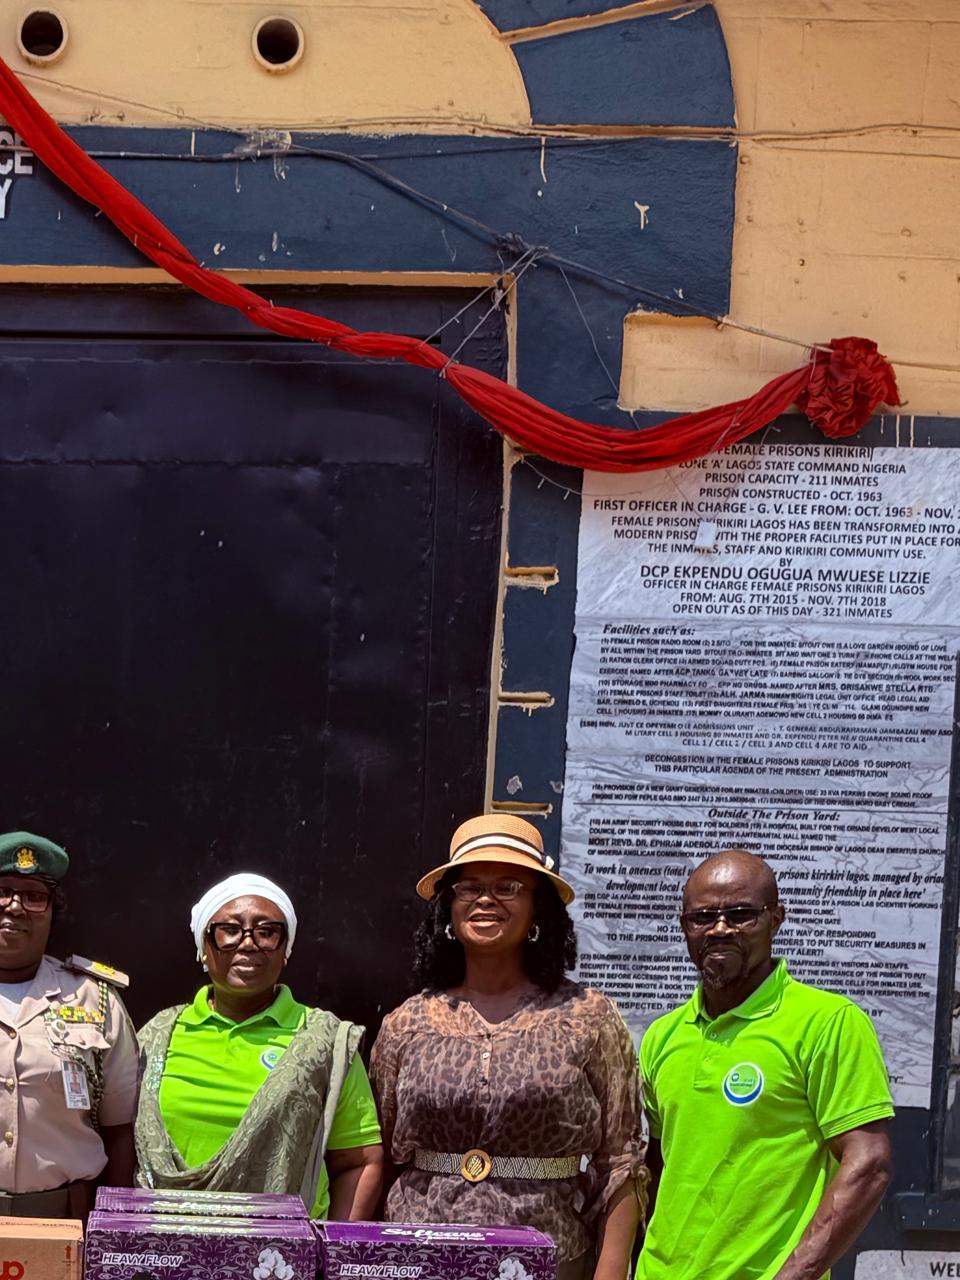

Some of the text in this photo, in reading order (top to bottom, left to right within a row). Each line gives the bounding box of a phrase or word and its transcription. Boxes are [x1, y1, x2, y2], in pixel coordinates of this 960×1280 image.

[769, 446, 820, 457] PRISONS
[824, 447, 871, 458] KIRIKIRI
[679, 460, 708, 469] ZONE
[727, 460, 761, 470] LAGOS
[765, 461, 795, 471] STATE
[798, 462, 859, 473] COMMAND
[862, 463, 906, 474] NIGERIA
[705, 473, 879, 486] PRISON CAPACITY 211 INMATES
[699, 488, 882, 501] PRISON CONSTRUCTED OCT. 1963
[594, 500, 625, 510] FIRST
[629, 501, 677, 512] OFFICER
[681, 502, 694, 512] IN
[697, 502, 746, 513] CHARGE
[758, 503, 770, 514] G.
[774, 504, 783, 514] V.
[788, 504, 807, 515] LEE
[812, 505, 851, 516] FROM:
[855, 506, 881, 517] OCT.
[885, 507, 913, 518] 1963
[612, 516, 955, 534] FEMALE PRISONS LAGOS HAS BEEN TRANSFORMED INTO
[614, 529, 960, 547] MODERN THE PROPER FACILITIES PUT IN PLACE FOR
[648, 543, 926, 559] THE STAFF AND KIRIKIRI COMMUNITY USE.
[780, 558, 792, 567] BY
[641, 565, 931, 584] DCP EKPENDU OGUGUA MWUESE LIZZIE
[643, 579, 925, 595] OFFICER IN CHARGE FEMALE PRISONS KIRIKIRI LAGOS
[681, 592, 886, 606] FROM: AUG. 7TH 2015 NOV. 7TH 2018
[673, 604, 892, 618] OPEN OUT AS THIS DAY 321 INMATES
[603, 624, 650, 635] Facilities
[708, 808, 840, 821] Outside The Prison Yard:
[103, 1253, 183, 1267] HEAVY FLOW
[340, 1264, 422, 1278] HEAVY FLOW
